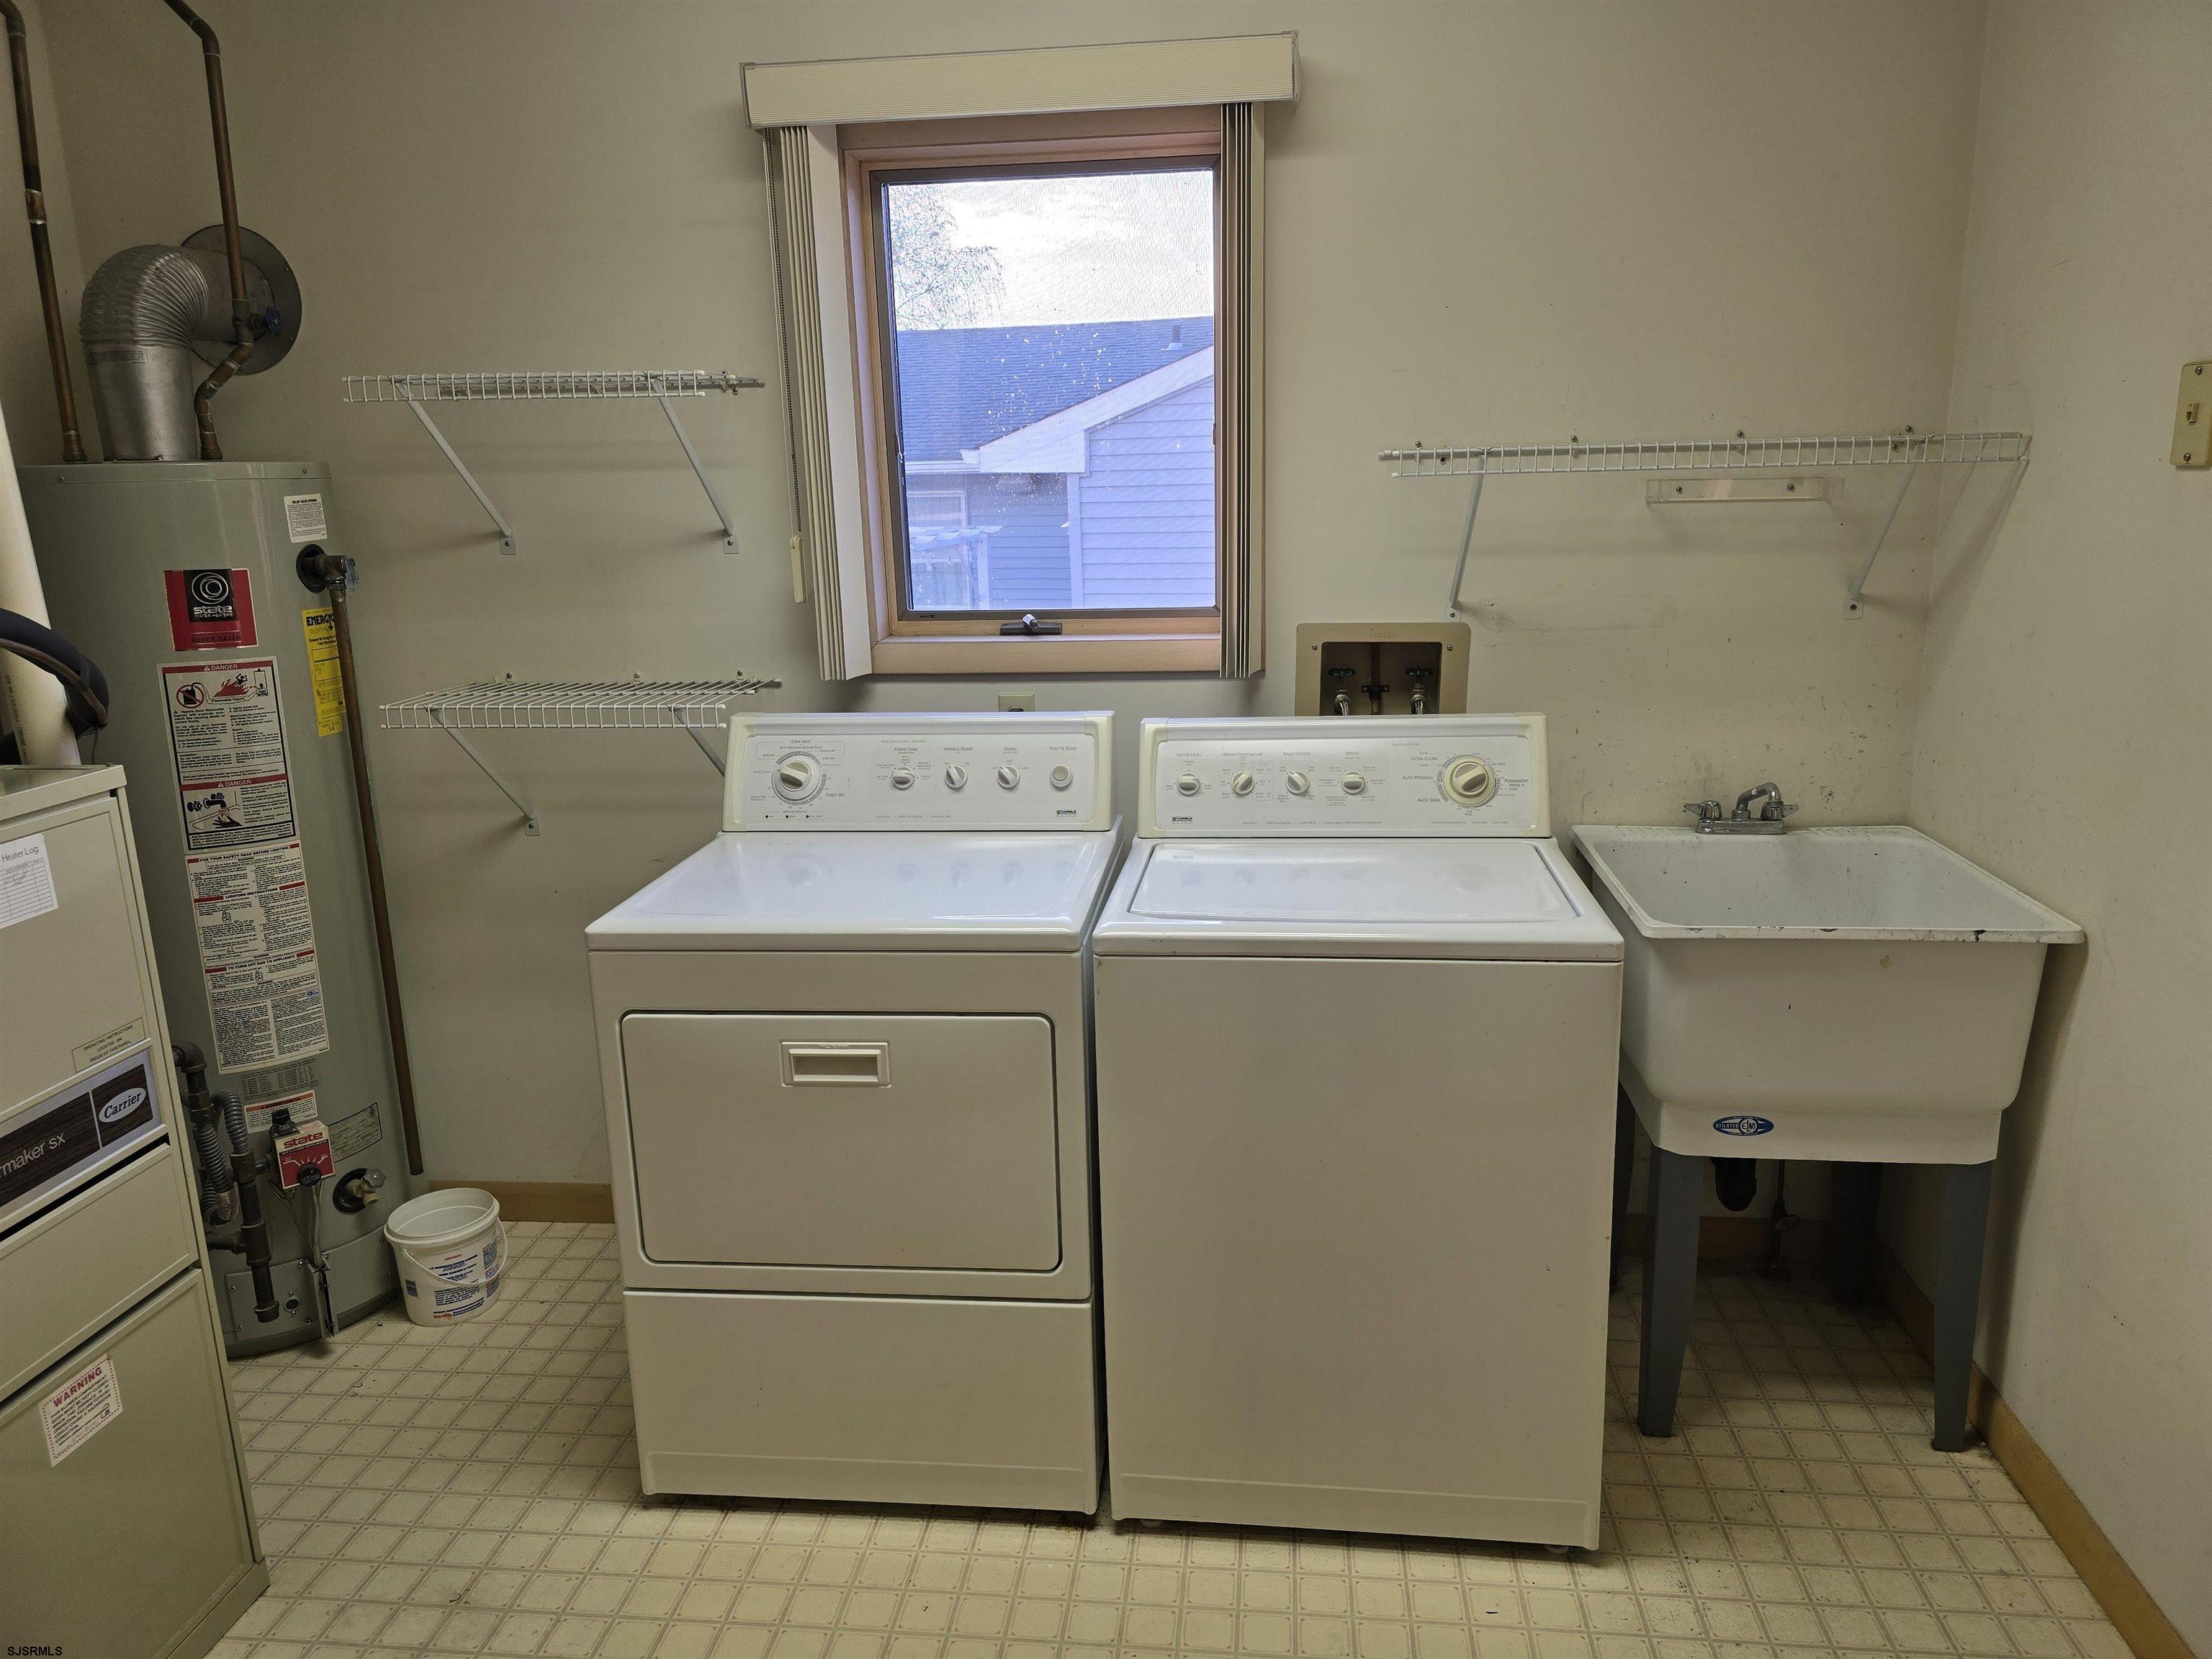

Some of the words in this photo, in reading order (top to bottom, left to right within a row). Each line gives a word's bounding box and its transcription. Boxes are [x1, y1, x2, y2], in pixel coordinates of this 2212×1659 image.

[193, 606, 233, 614] state
[1, 851, 23, 863] Heater
[24, 846, 39, 855] Log
[83, 1038, 105, 1051] OPERATING
[106, 1025, 132, 1040] INSTRUCTIONS
[96, 1040, 114, 1051] LOCATED
[89, 1053, 102, 1062] INSIDE
[104, 1092, 142, 1119] Carrier
[265, 1097, 300, 1108] ADVERTENCIA
[1742, 1120, 1755, 1132] ELM
[49, 1133, 66, 1149] sx
[283, 1132, 323, 1149] state
[53, 1367, 102, 1408] WARNING
[77, 1375, 107, 1398] COMPARTMENT
[51, 1413, 63, 1424] DOOR
[63, 1404, 75, 1414] MUST
[81, 1390, 92, 1401] KEPT
